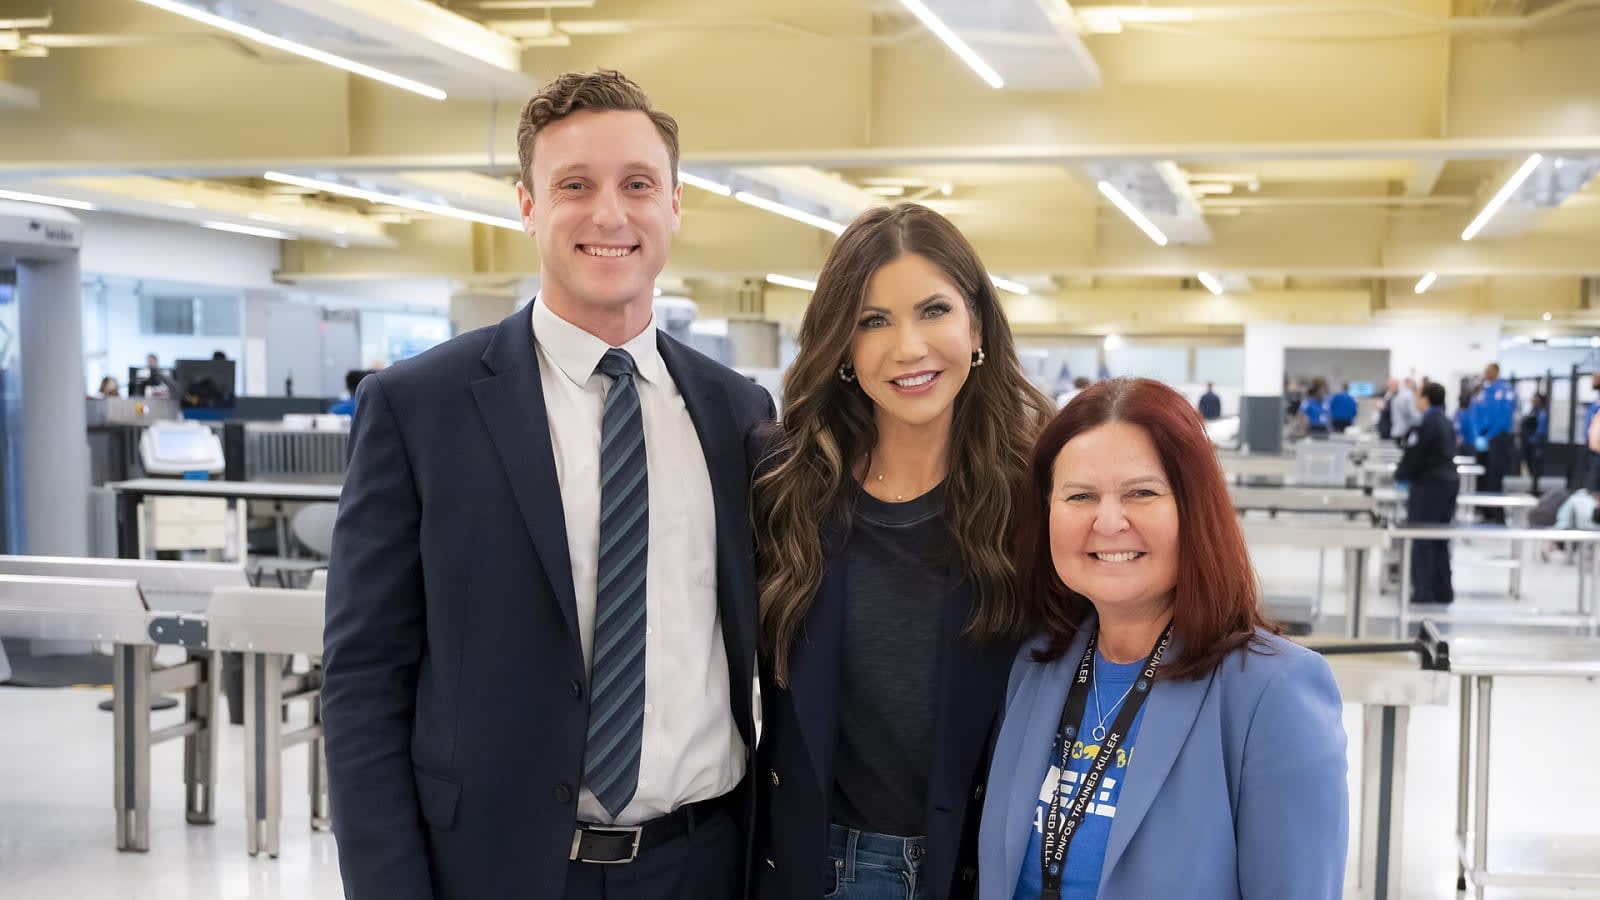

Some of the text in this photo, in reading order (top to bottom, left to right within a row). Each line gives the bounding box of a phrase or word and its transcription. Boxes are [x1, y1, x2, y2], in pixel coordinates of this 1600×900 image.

[1144, 639, 1169, 678] DINFOS
[1054, 732, 1120, 861] DINFOS TRAINED KILLER
[1045, 832, 1054, 867] KILL
